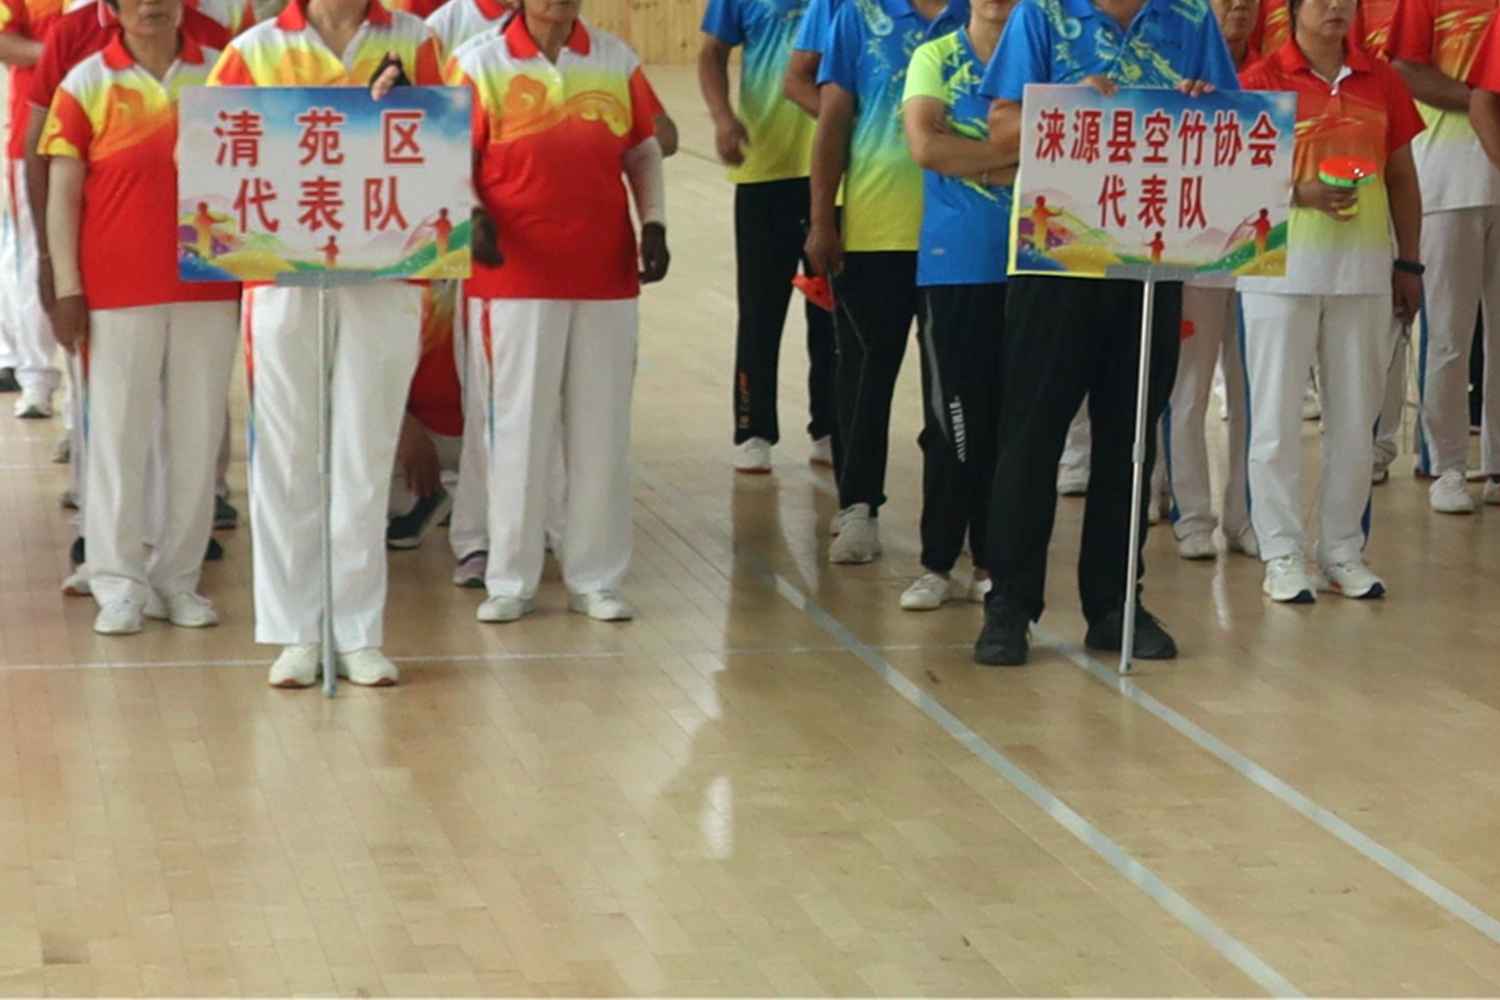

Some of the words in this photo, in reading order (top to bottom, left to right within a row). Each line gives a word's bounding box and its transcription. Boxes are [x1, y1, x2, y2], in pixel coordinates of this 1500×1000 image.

[214, 110, 425, 167] 清苑区
[1035, 109, 1280, 168] 涞源县空竹协会
[232, 178, 409, 234] 代表队
[1098, 175, 1208, 229] 代表队
